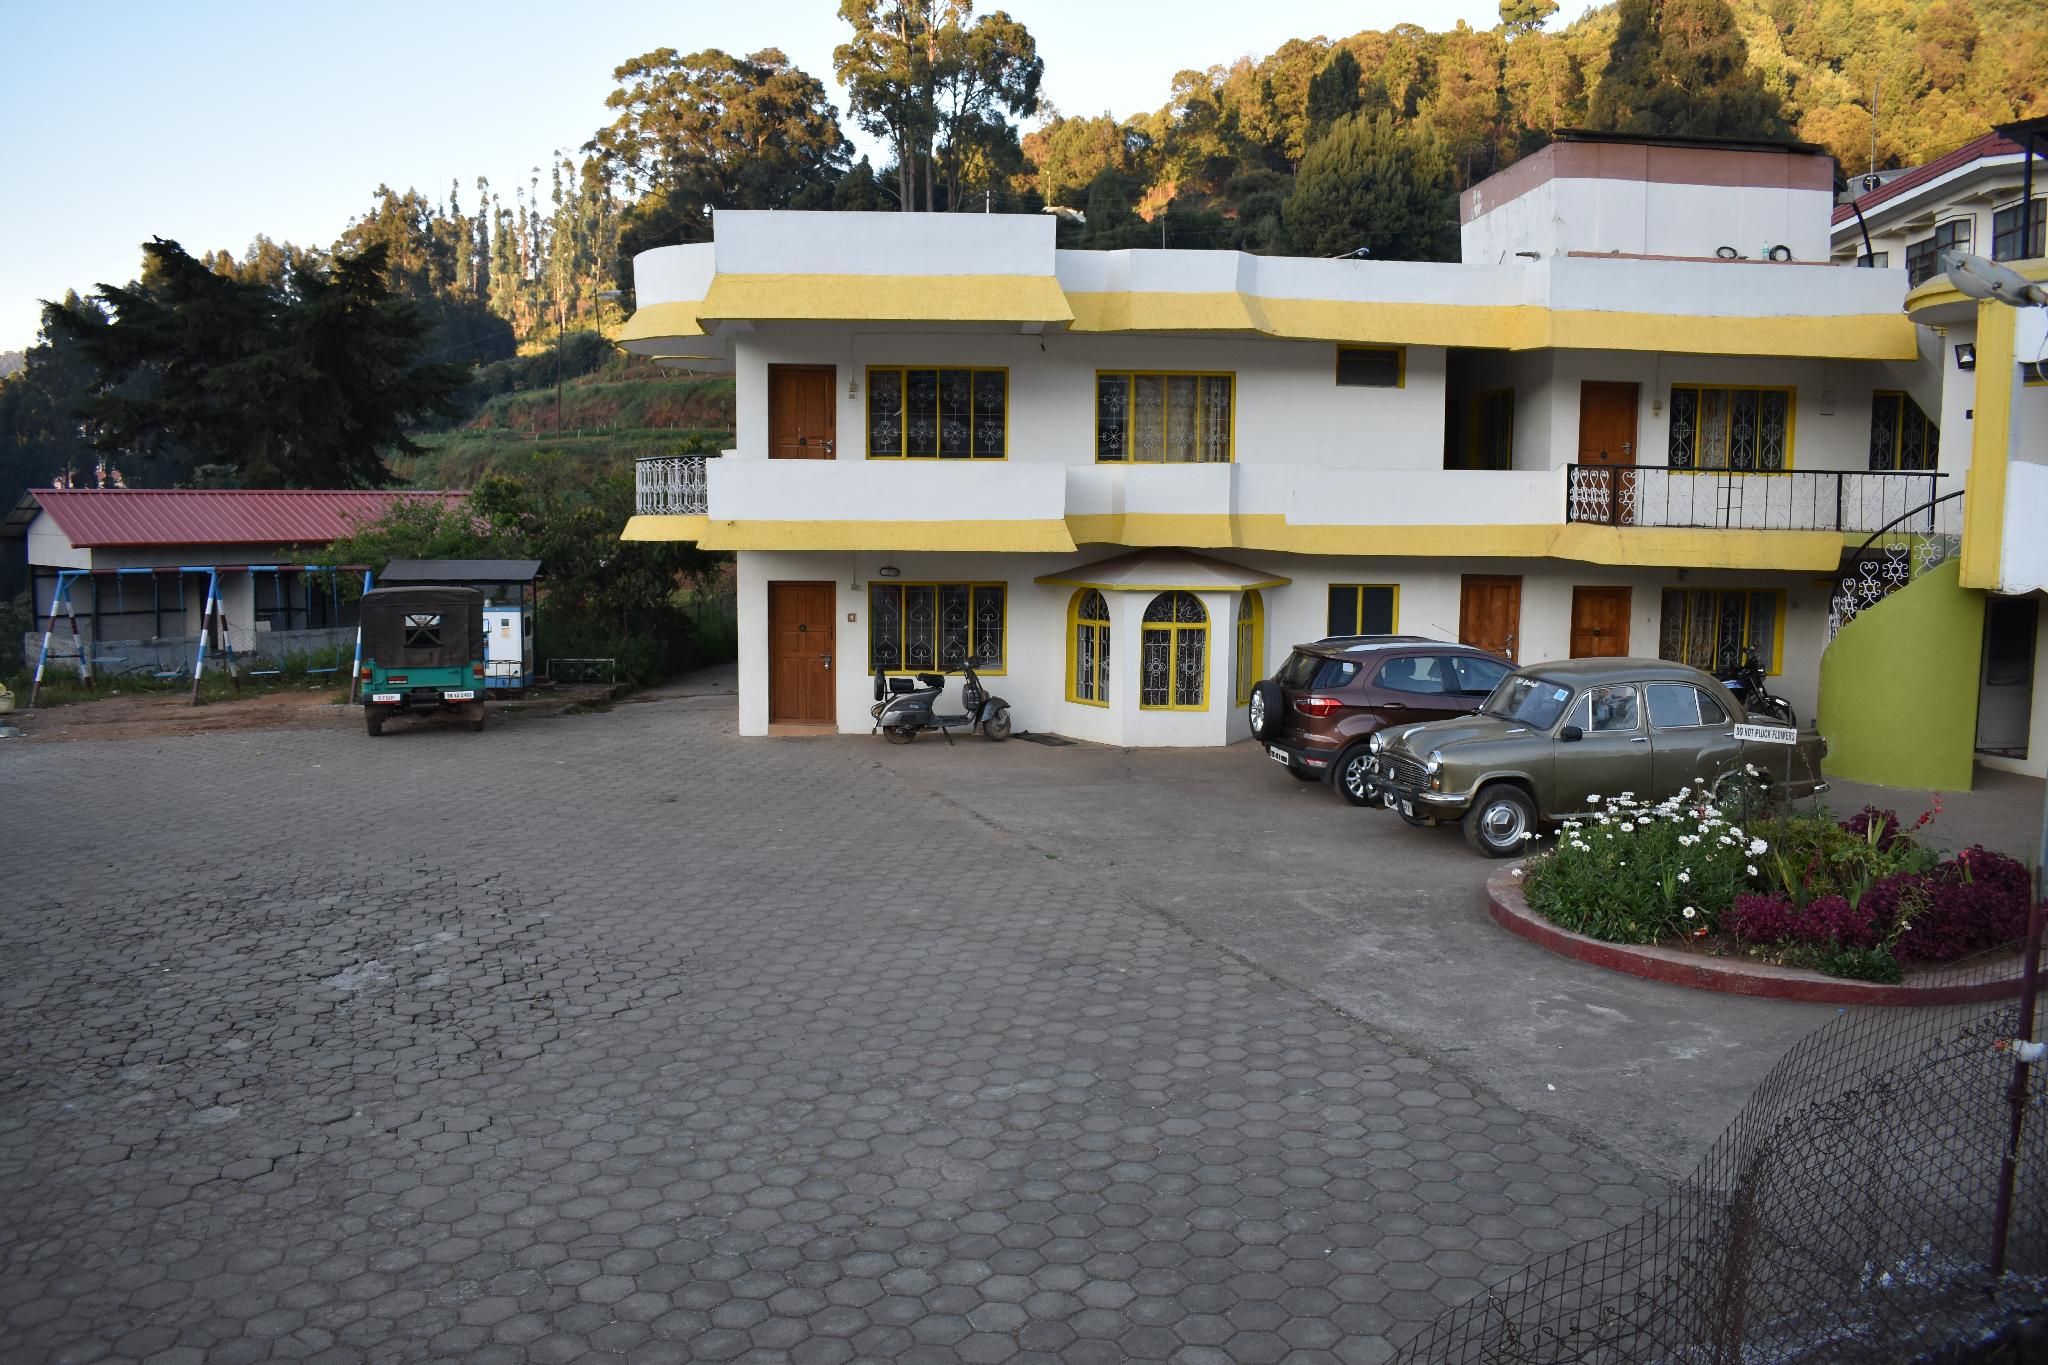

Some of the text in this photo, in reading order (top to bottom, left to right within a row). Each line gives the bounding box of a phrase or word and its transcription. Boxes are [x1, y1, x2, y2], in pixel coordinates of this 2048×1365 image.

[1736, 726, 1795, 741] DO NOT PLUCK FLOWERS
